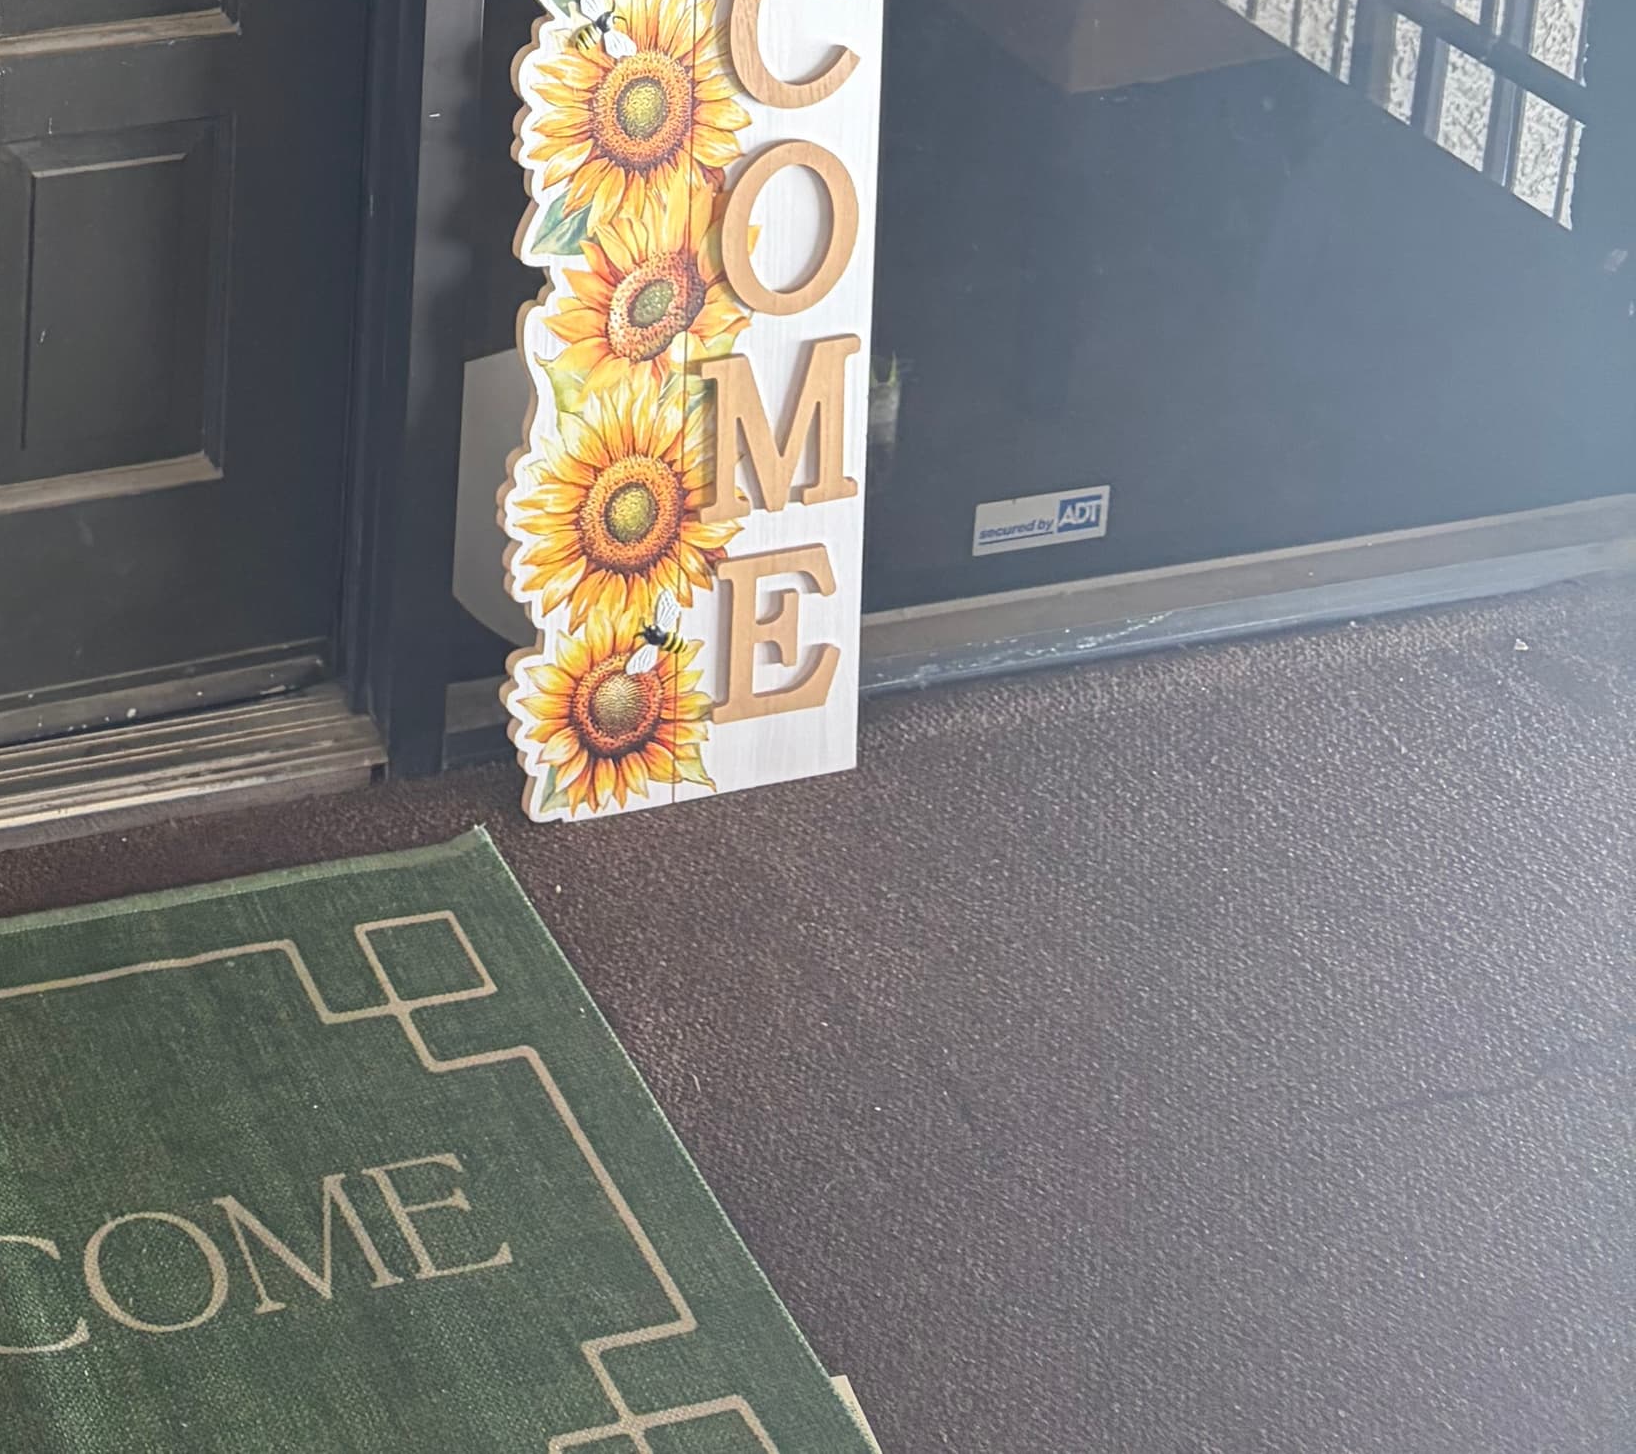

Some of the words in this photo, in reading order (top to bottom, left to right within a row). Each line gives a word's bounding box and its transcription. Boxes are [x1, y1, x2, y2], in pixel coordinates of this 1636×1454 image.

[979, 520, 1036, 540] secured
[1037, 518, 1054, 532] by
[1058, 500, 1102, 528] ADT
